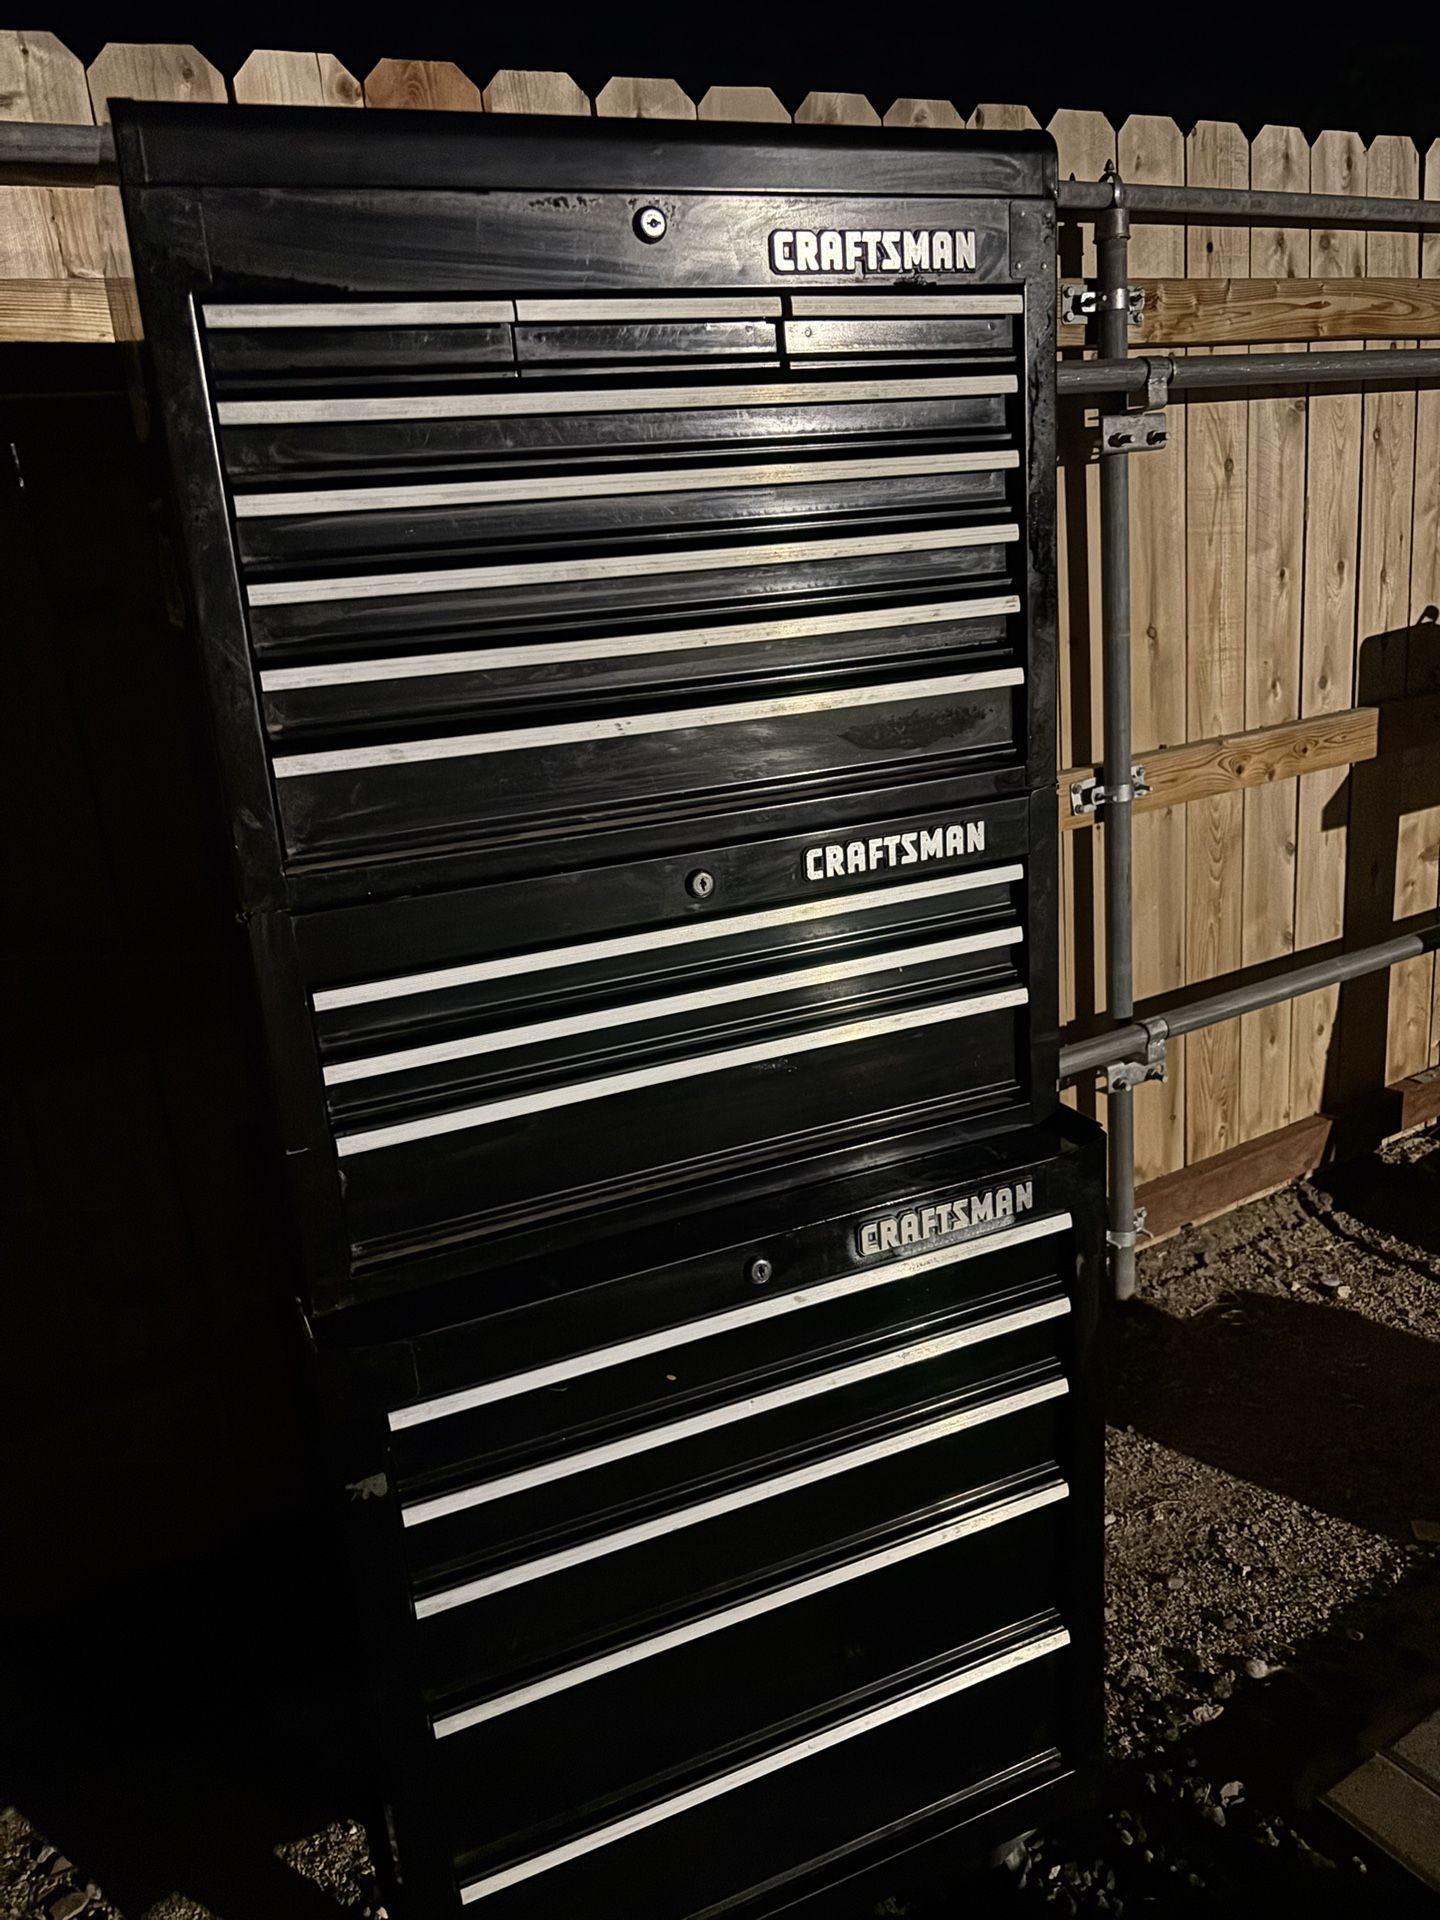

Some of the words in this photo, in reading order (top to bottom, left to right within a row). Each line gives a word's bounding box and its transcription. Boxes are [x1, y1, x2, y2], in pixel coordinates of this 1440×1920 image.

[773, 231, 976, 271] CRAFTSMAN
[806, 820, 986, 881] CRAFTSMAN
[861, 1181, 1033, 1256] CRAFTSMAN
